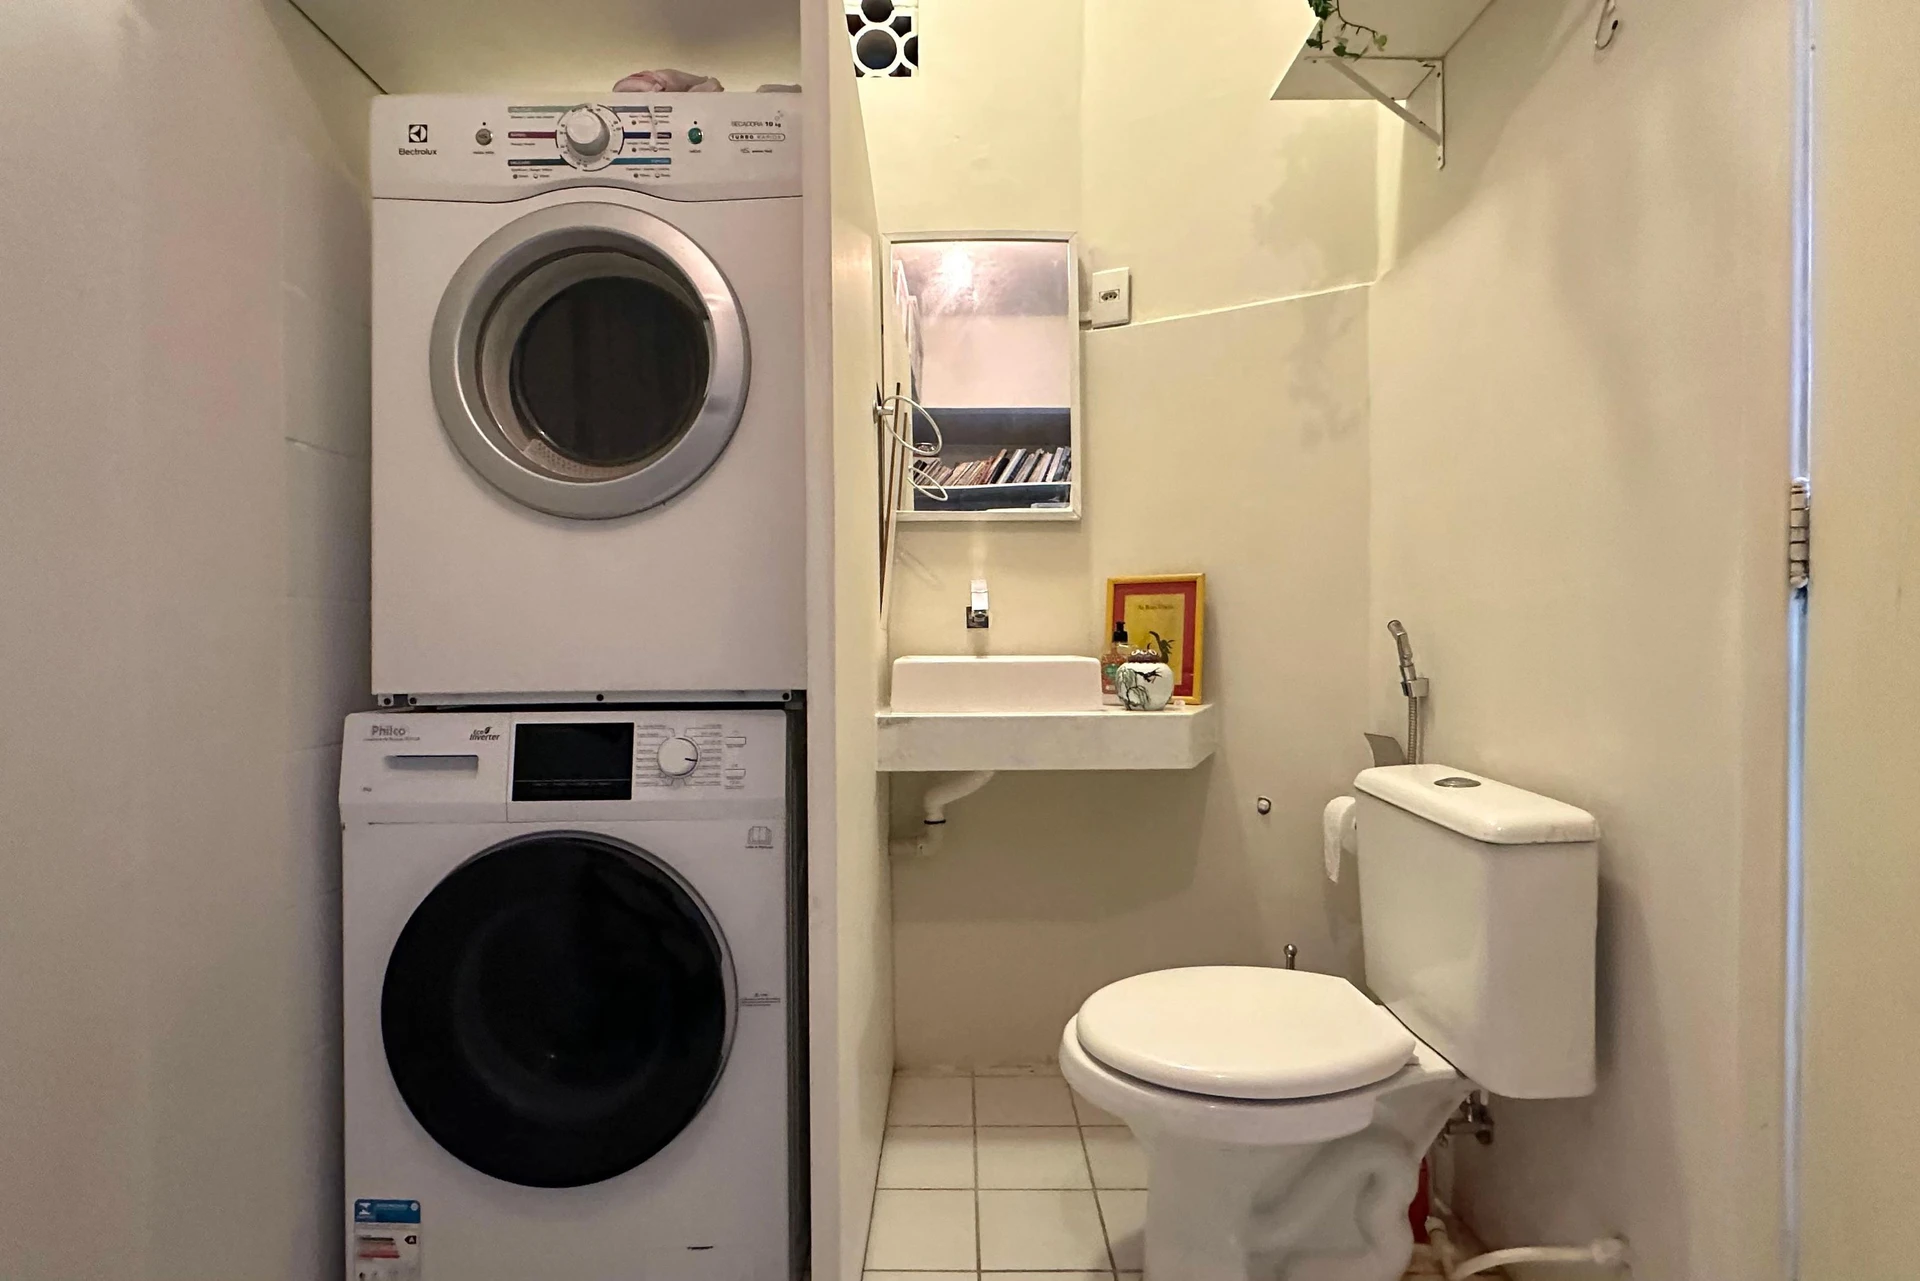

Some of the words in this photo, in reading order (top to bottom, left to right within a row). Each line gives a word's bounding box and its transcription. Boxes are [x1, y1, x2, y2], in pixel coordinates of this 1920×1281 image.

[398, 148, 437, 156] Electrolux
[371, 725, 406, 737] Philco
[469, 733, 500, 741] Inverter
